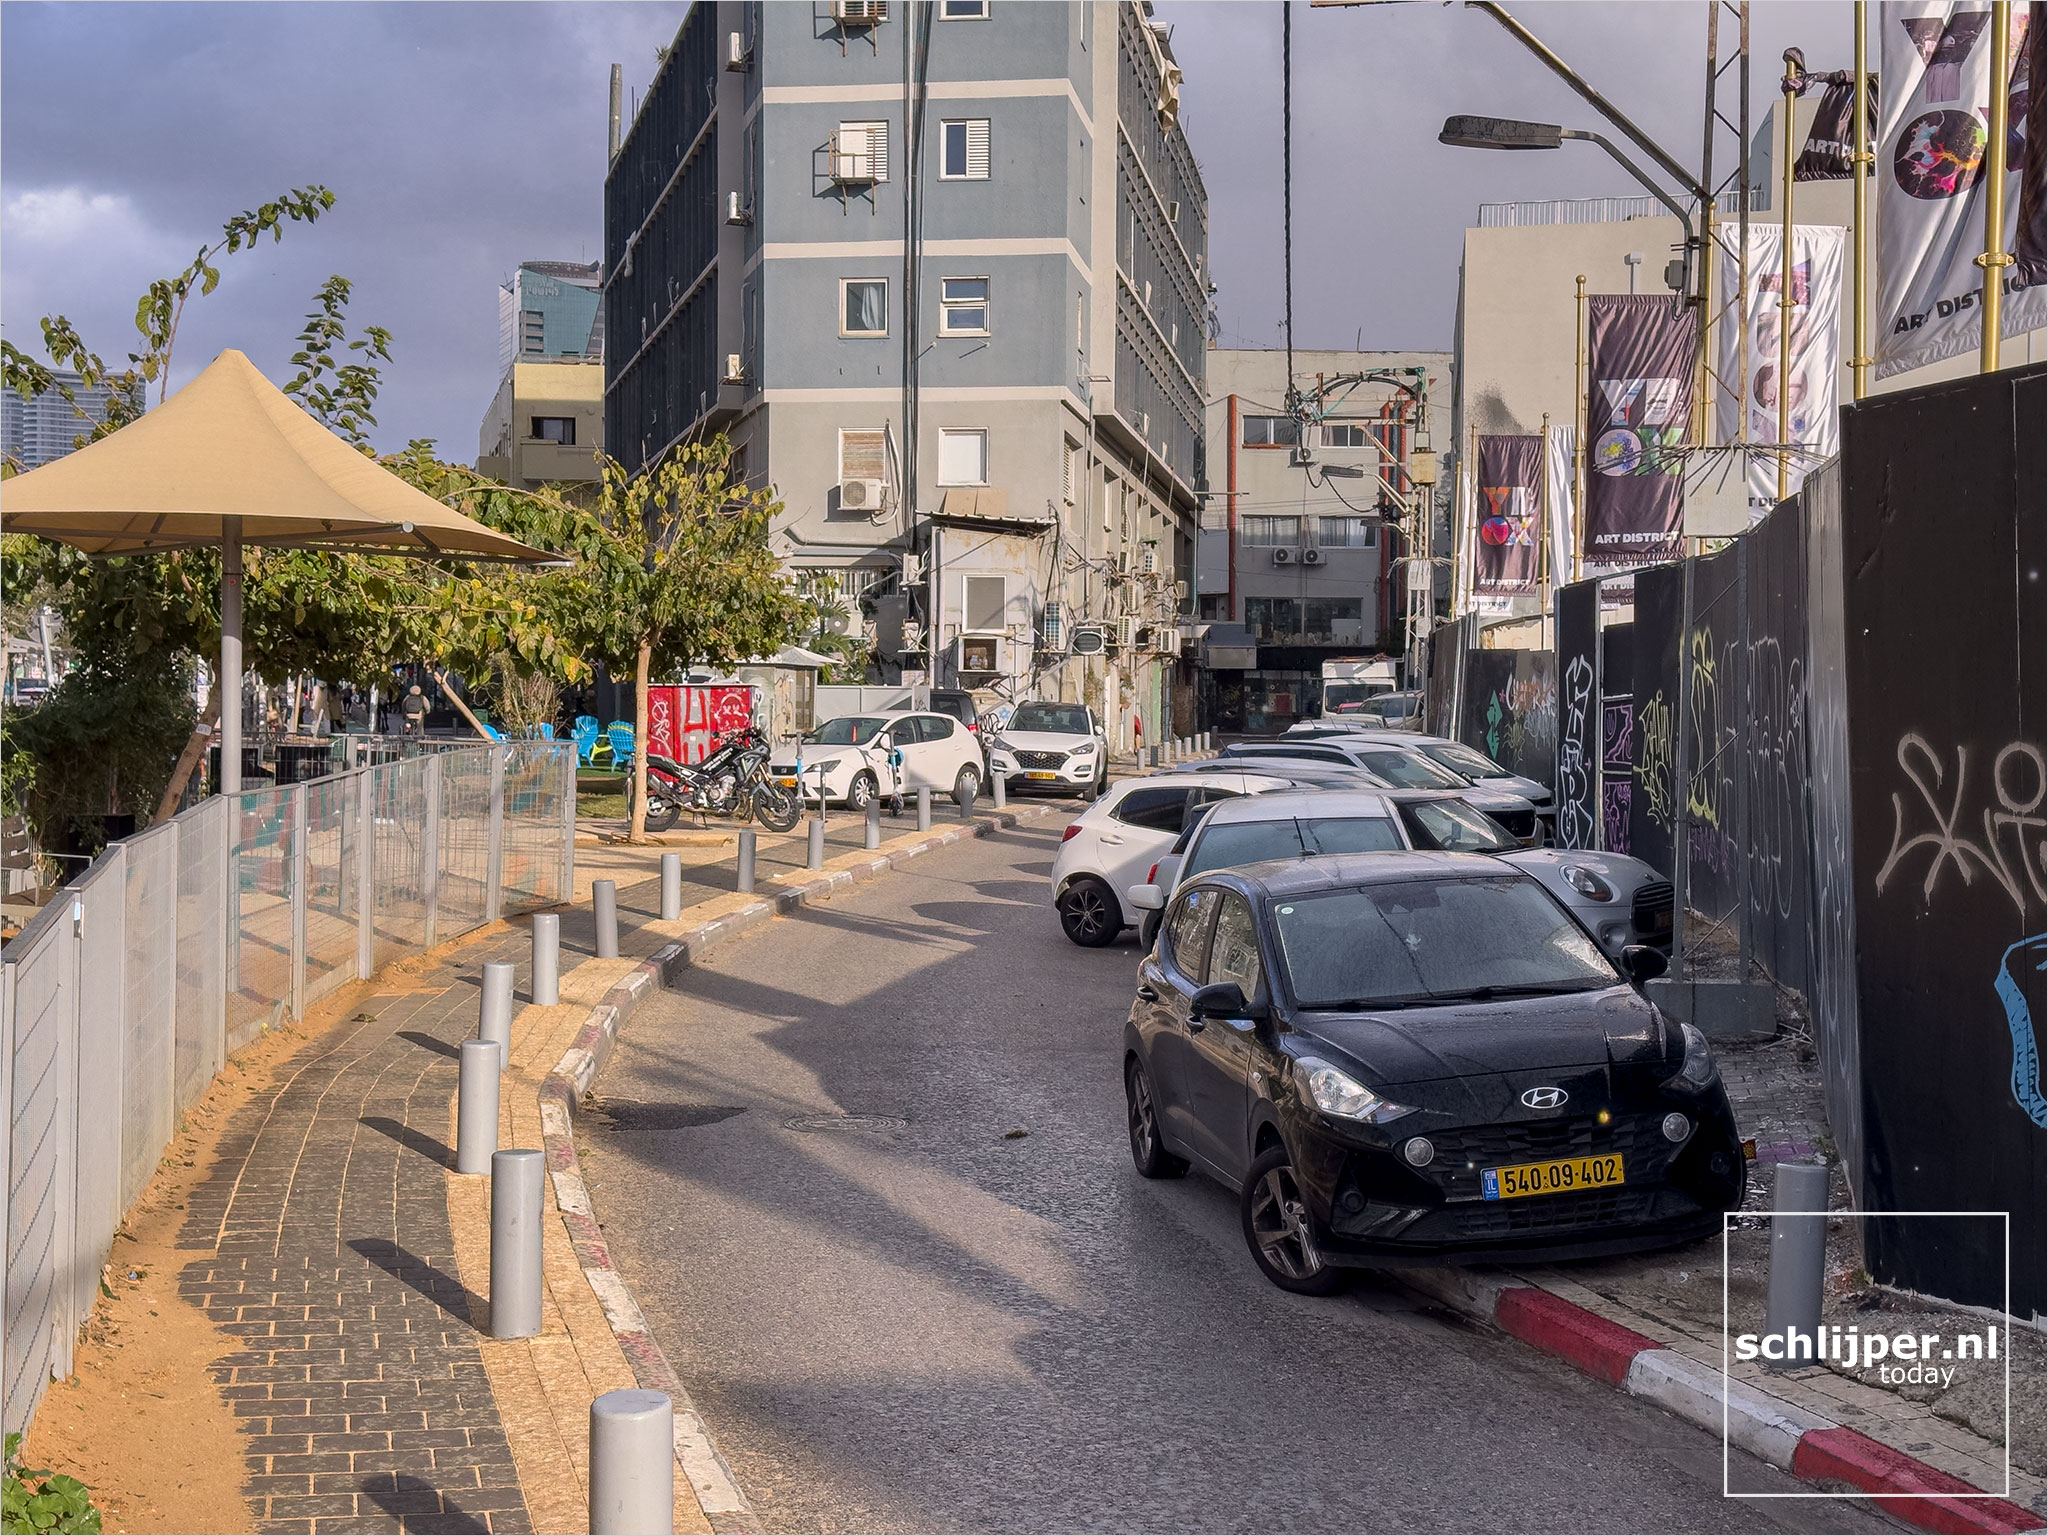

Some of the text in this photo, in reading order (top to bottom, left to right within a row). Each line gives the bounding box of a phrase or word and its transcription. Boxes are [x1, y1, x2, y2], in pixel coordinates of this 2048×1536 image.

[1804, 138, 1841, 155] ART
[1594, 530, 1680, 545] ART DISTRICT
